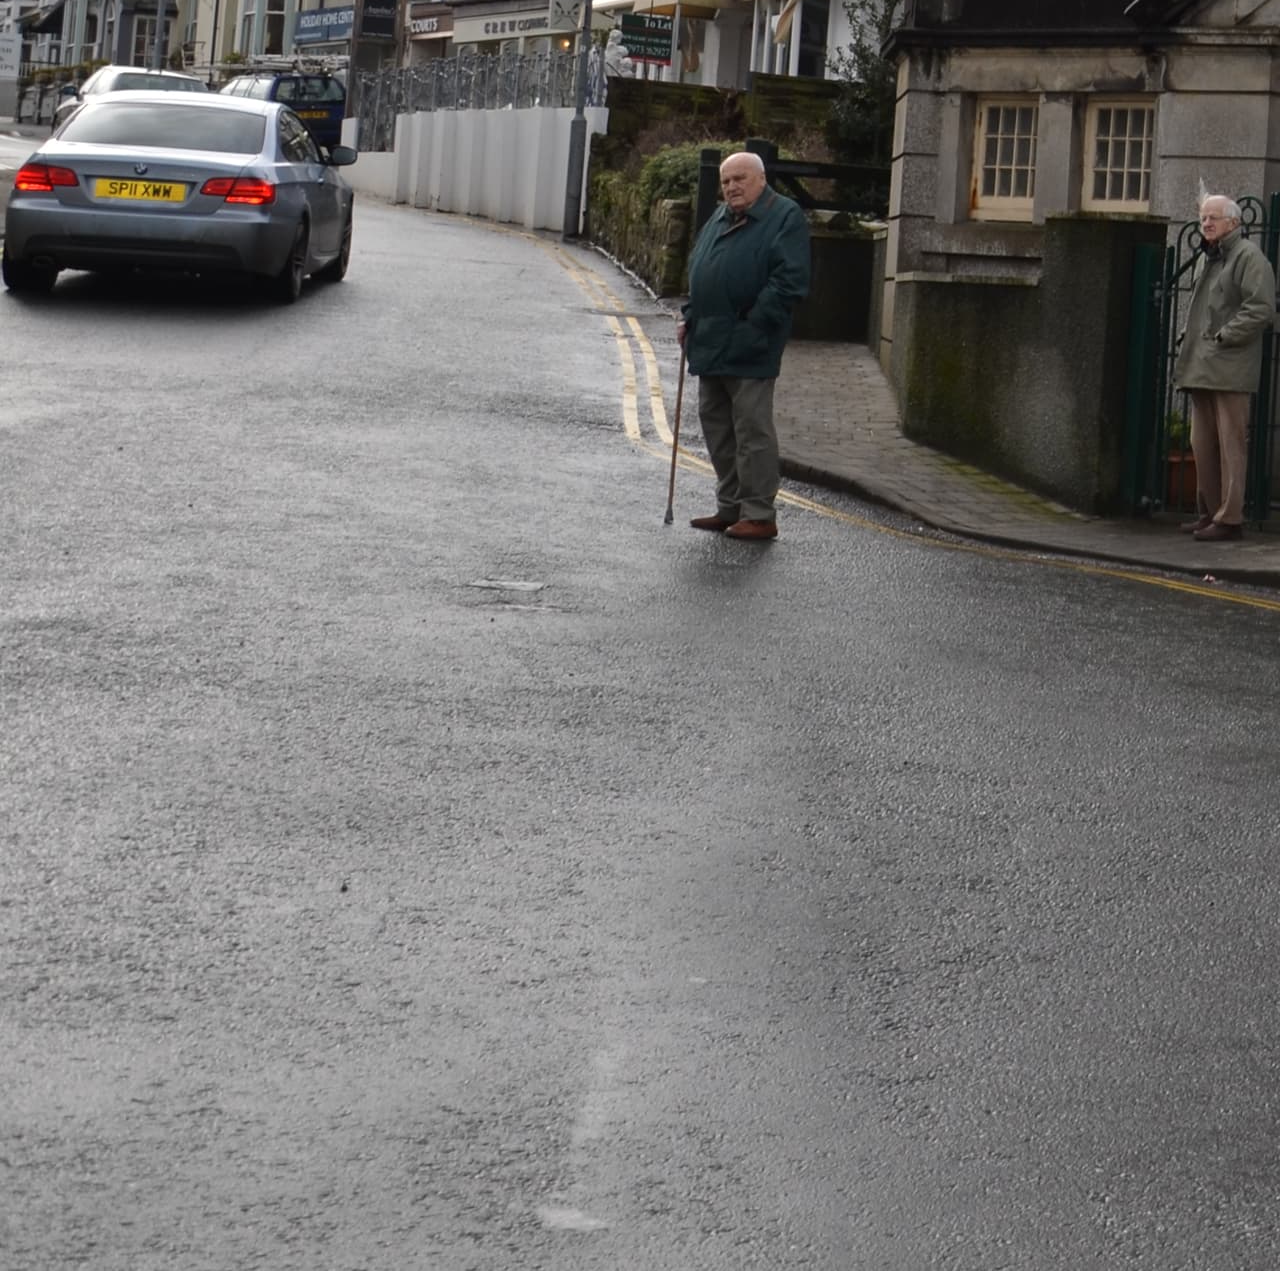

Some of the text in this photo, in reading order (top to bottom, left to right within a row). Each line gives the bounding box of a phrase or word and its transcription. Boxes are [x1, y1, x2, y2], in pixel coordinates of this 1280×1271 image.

[484, 20, 516, 34] CREW
[109, 182, 173, 198] SP11 XWW
